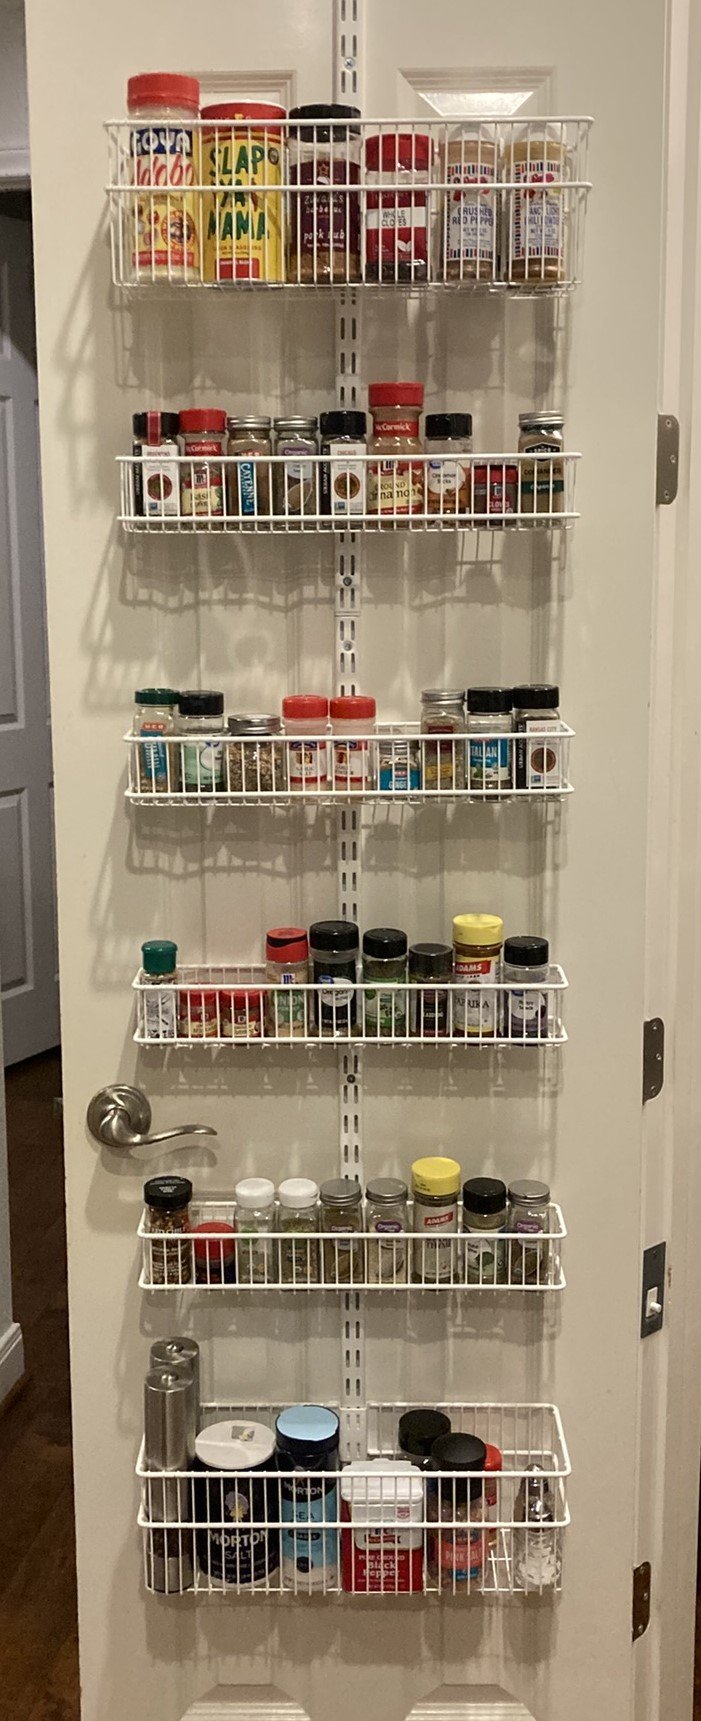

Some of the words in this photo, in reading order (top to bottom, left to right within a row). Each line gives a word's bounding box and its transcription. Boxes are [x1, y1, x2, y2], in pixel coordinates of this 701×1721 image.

[132, 130, 191, 153] GOYA
[209, 145, 265, 177] SLAP
[207, 210, 270, 241] MAMA
[381, 218, 407, 227] CLOES
[470, 216, 494, 227] PEPPE
[240, 463, 255, 505] CAYENNE
[469, 745, 498, 758] TALAN
[208, 1529, 268, 1548] MORTON
[224, 1550, 251, 1560] SALT
[367, 1561, 397, 1569] Black
